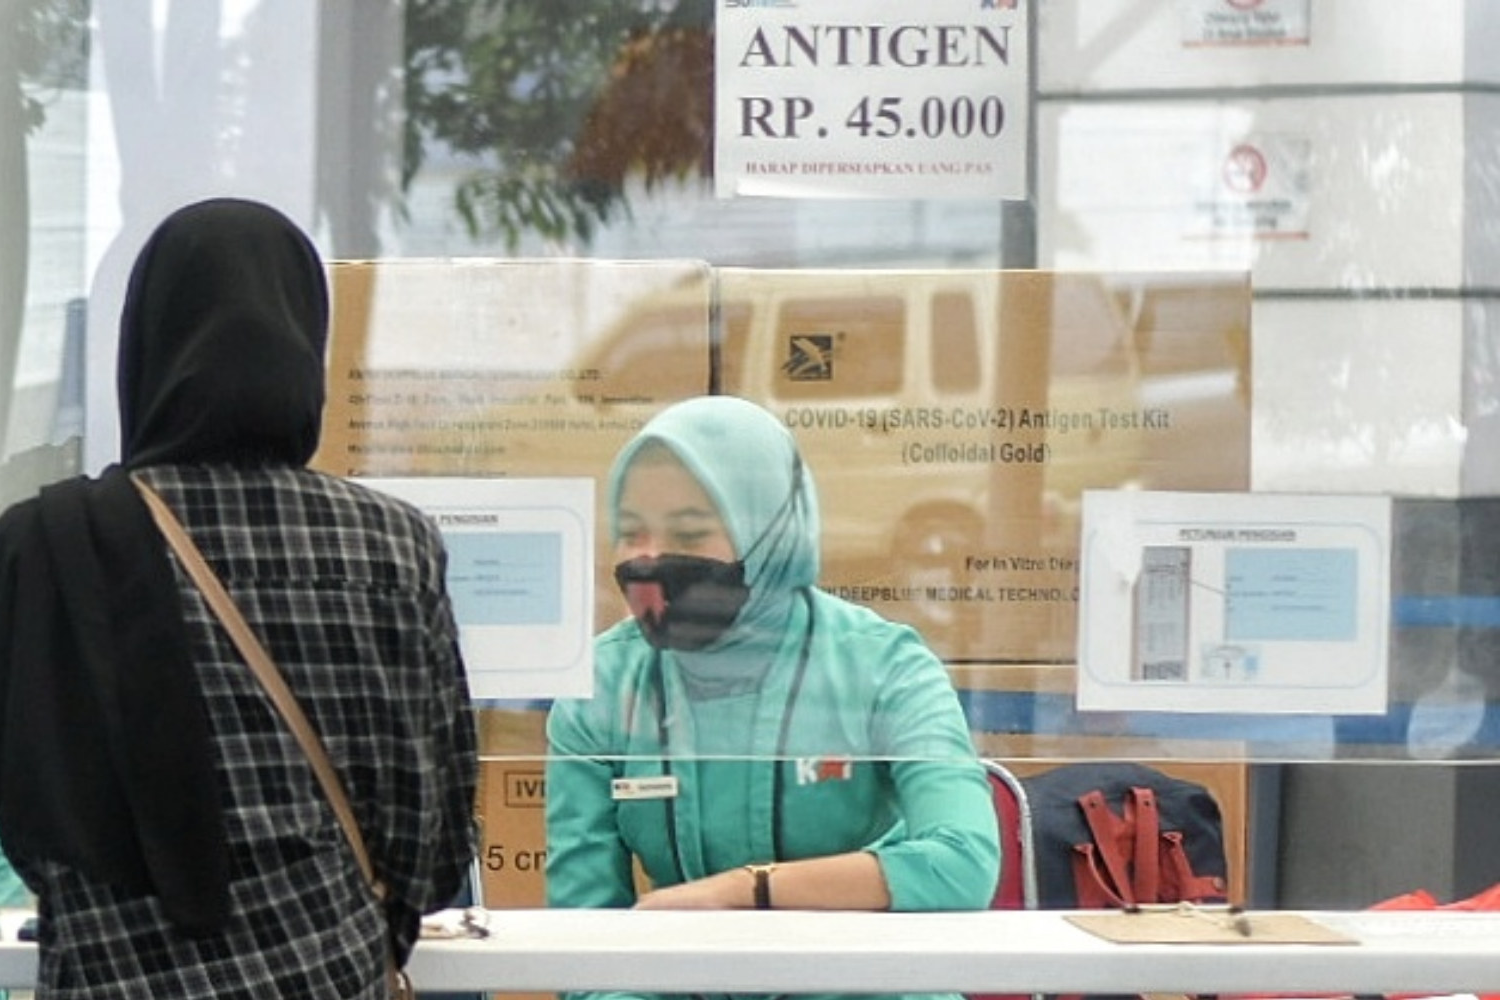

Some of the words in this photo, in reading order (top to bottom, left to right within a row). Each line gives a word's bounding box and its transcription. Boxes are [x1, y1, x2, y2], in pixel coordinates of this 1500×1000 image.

[738, 25, 1012, 67] ANTIGEN
[738, 96, 828, 139] RP.
[845, 95, 1005, 139] 45.000
[746, 162, 798, 175] HARAP
[801, 161, 913, 175] DIPERSIAPKAN
[964, 162, 992, 175] PAS
[785, 408, 877, 428] COVID-19
[882, 407, 1014, 432] (SARS-CoV-2)
[1019, 408, 1092, 433] Antigen
[1099, 408, 1138, 428] Test
[1143, 408, 1169, 428] Kit
[901, 442, 996, 465] (Colloidal
[999, 442, 1052, 464] Gold)
[965, 557, 989, 572] For
[992, 558, 1007, 571] In
[1009, 557, 1044, 571] Vitro
[926, 587, 993, 600] MEDICAL
[515, 780, 546, 798] IV
